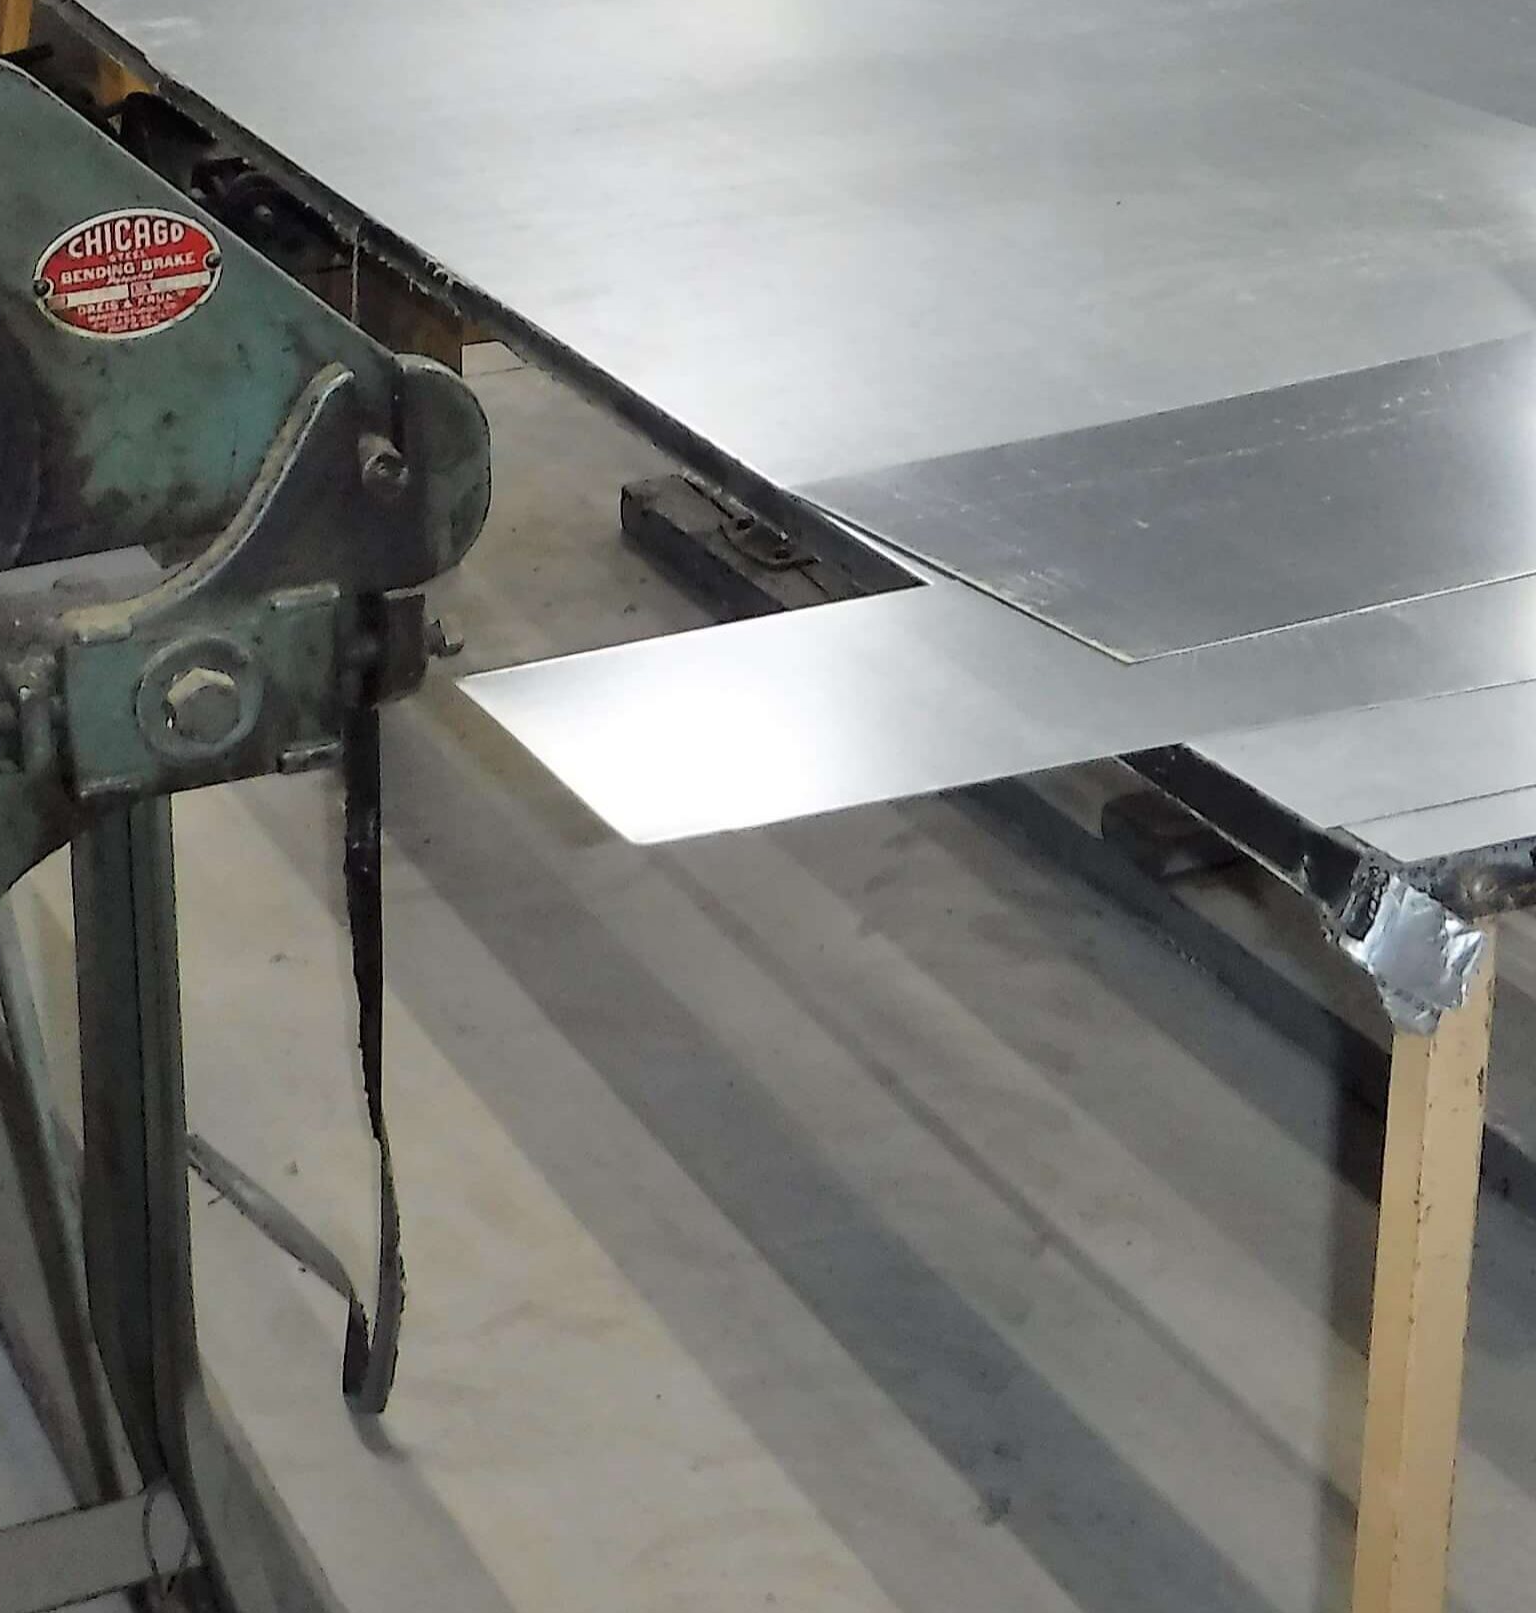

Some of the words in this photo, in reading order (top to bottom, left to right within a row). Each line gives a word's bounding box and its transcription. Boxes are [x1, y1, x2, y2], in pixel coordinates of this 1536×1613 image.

[67, 218, 185, 258] CHICAGO
[60, 261, 136, 284] BENDING
[141, 251, 196, 272] BRAKE
